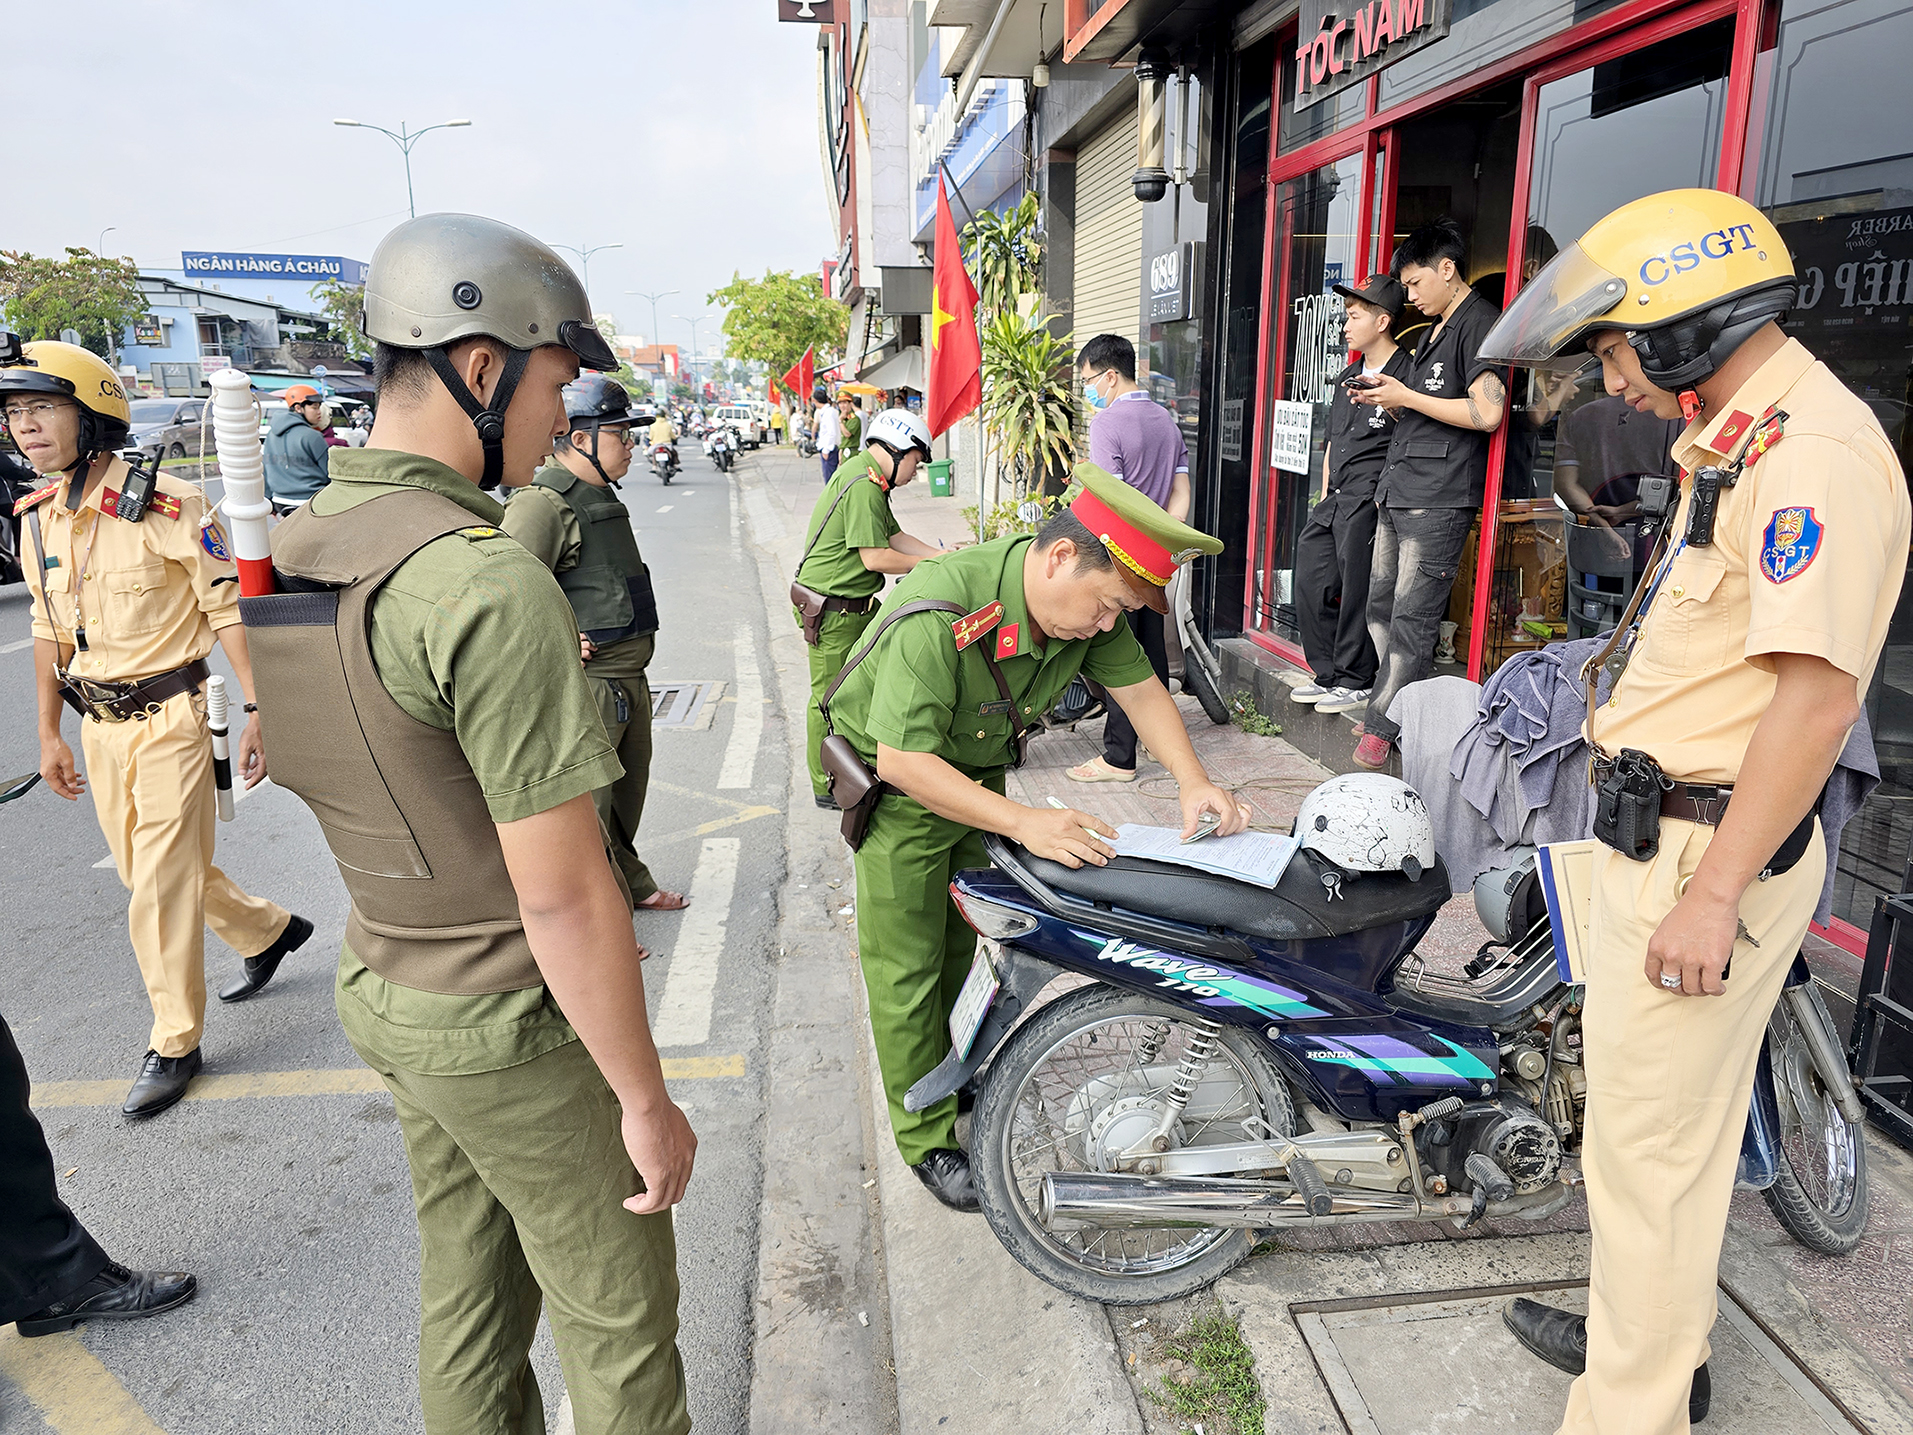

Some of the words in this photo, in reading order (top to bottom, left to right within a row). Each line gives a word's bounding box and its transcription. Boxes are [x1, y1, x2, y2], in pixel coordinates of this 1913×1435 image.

[1296, 15, 1349, 94] TÓC
[1354, 0, 1426, 63] NAM
[185, 255, 234, 271] NGÂN
[236, 256, 281, 273] HÀNG
[284, 257, 296, 273] Á
[297, 258, 341, 275] CHÂU
[1639, 223, 1757, 286] CSGT
[1150, 250, 1180, 293] 689
[1291, 294, 1329, 403] 70K
[100, 380, 127, 402] CS
[880, 415, 914, 435] CSTT
[1763, 545, 1809, 560] CSGT
[1097, 939, 1235, 981] Wave
[1156, 979, 1219, 997] 110
[1306, 1050, 1356, 1060] HONDA
